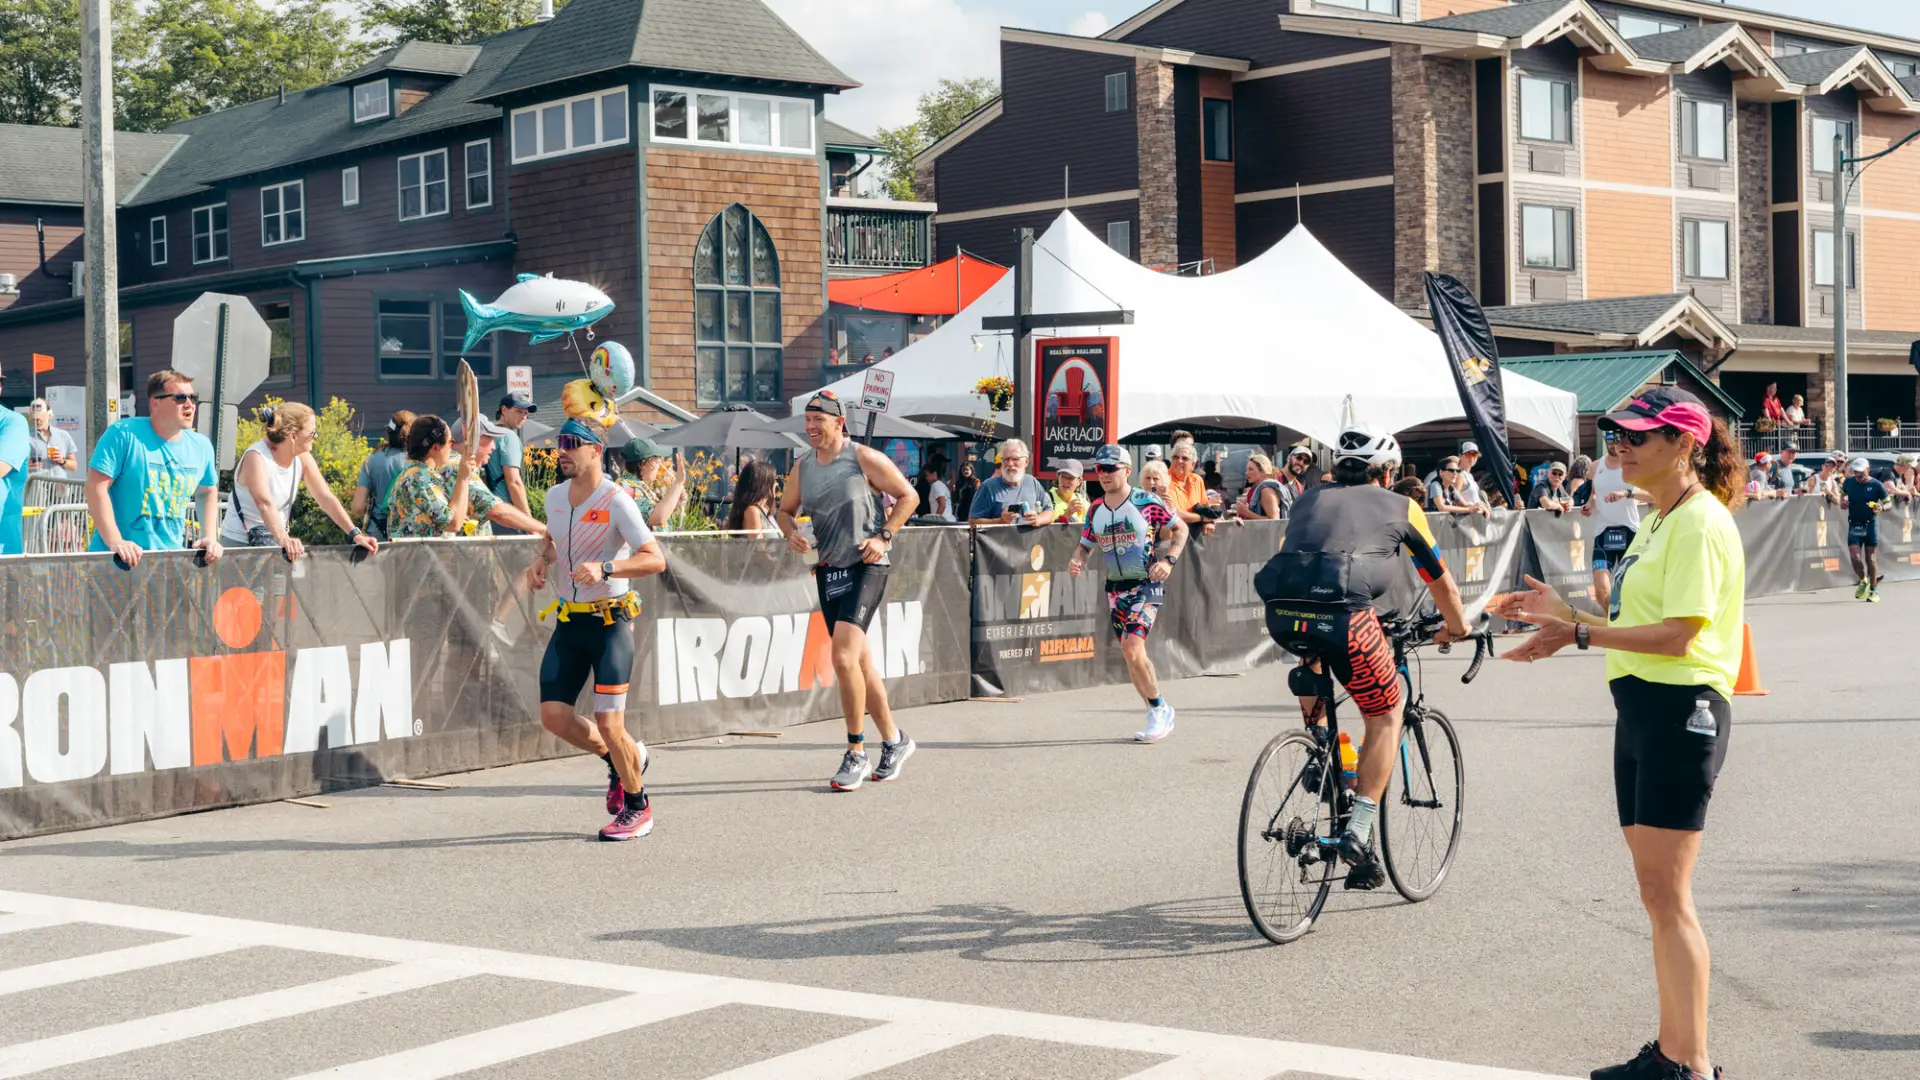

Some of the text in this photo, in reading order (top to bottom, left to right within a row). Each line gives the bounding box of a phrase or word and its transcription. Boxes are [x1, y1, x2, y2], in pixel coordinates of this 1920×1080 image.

[874, 374, 885, 383] NO
[865, 384, 890, 396] PARKING
[109, 399, 116, 412] 5
[1045, 426, 1104, 442] LAKE PLACID
[1053, 442, 1096, 454] pub & brewery
[1024, 647, 1034, 657] BY
[1040, 636, 1095, 656] NIRVANA
